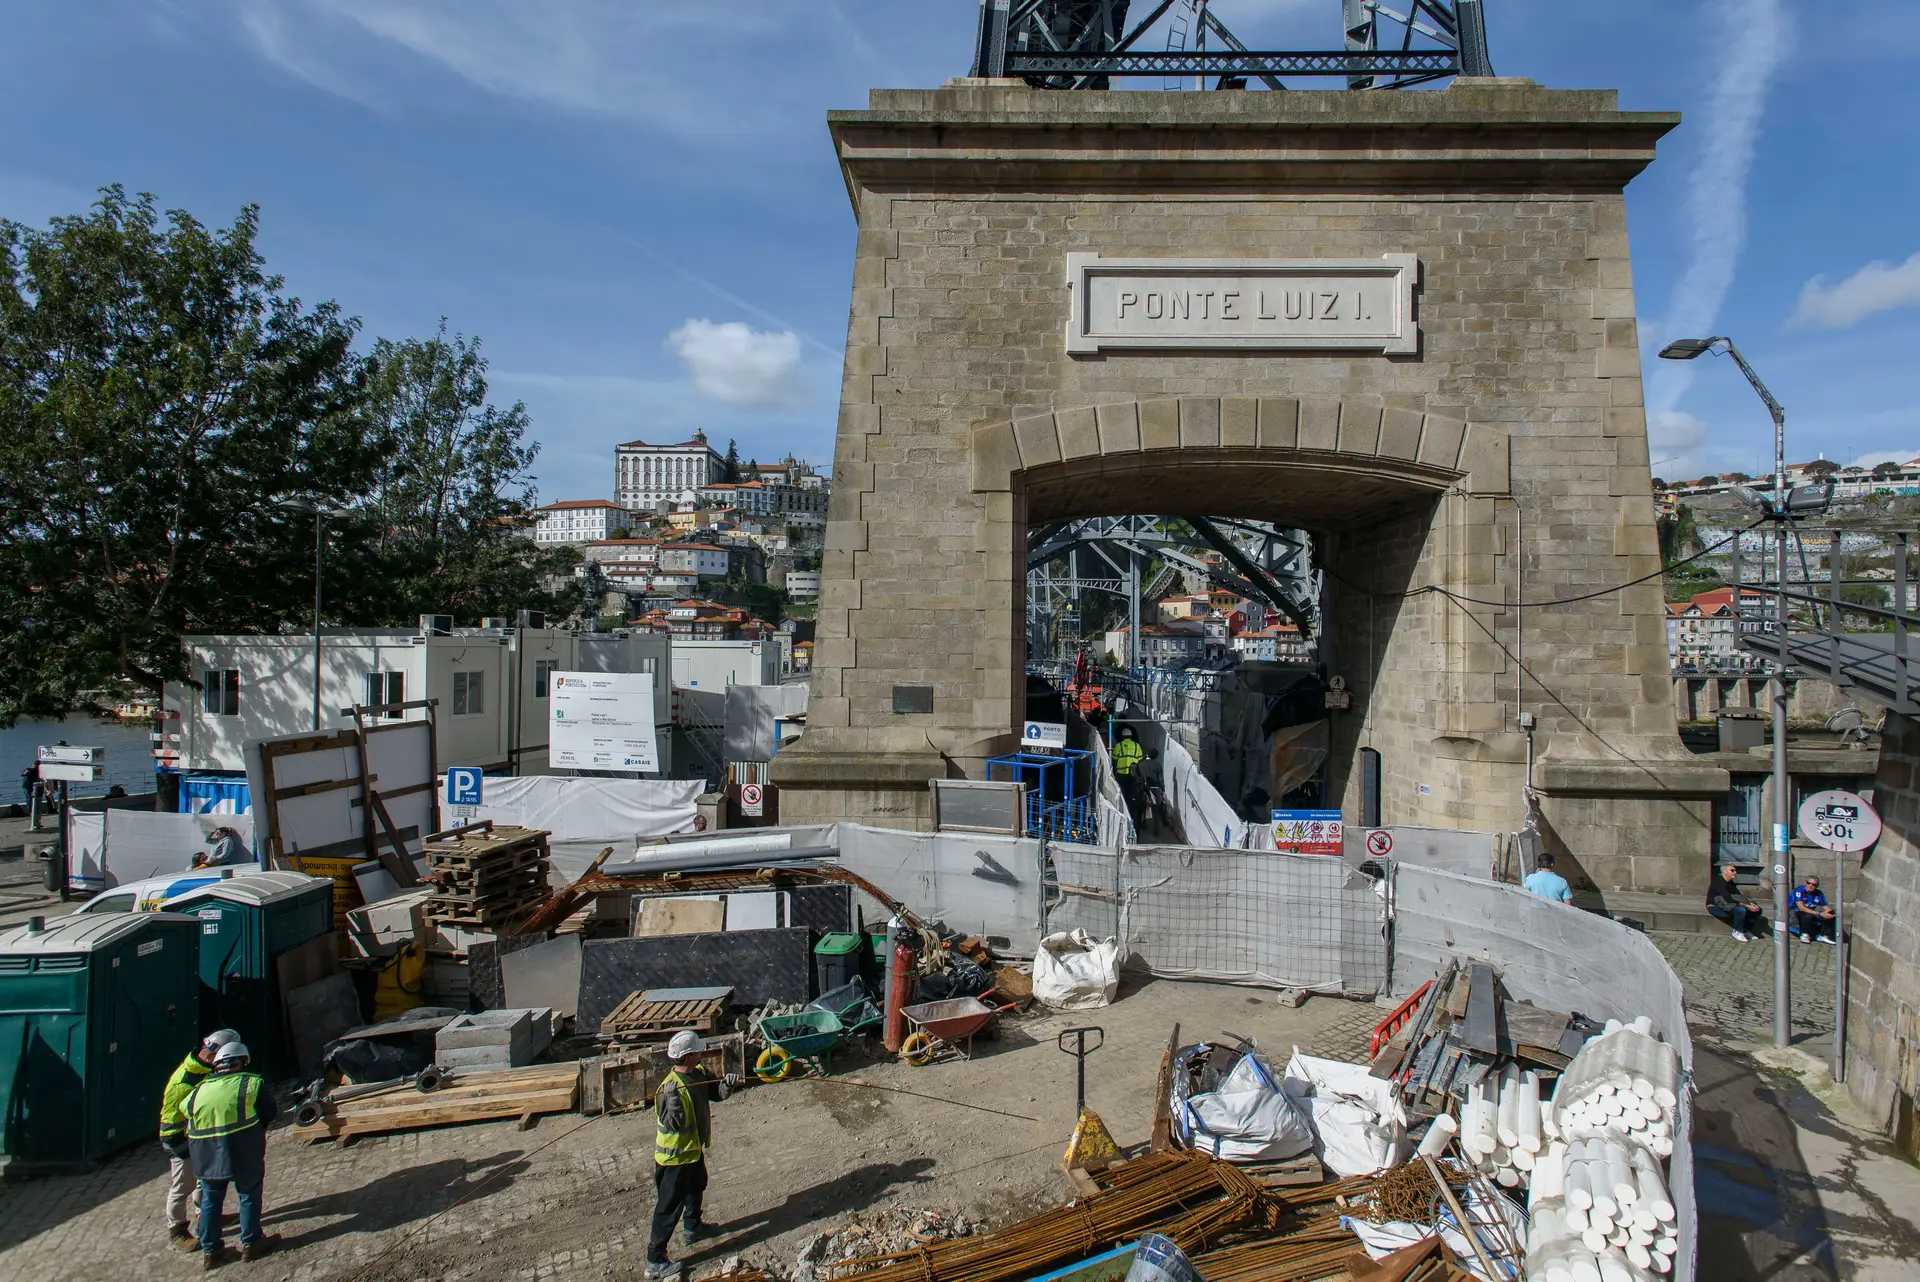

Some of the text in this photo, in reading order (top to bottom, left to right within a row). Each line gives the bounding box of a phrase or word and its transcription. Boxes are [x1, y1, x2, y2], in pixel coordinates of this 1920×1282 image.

[1118, 291, 1371, 320] PONTE LUIZ I.
[42, 750, 57, 758] Porto
[455, 771, 475, 802] P
